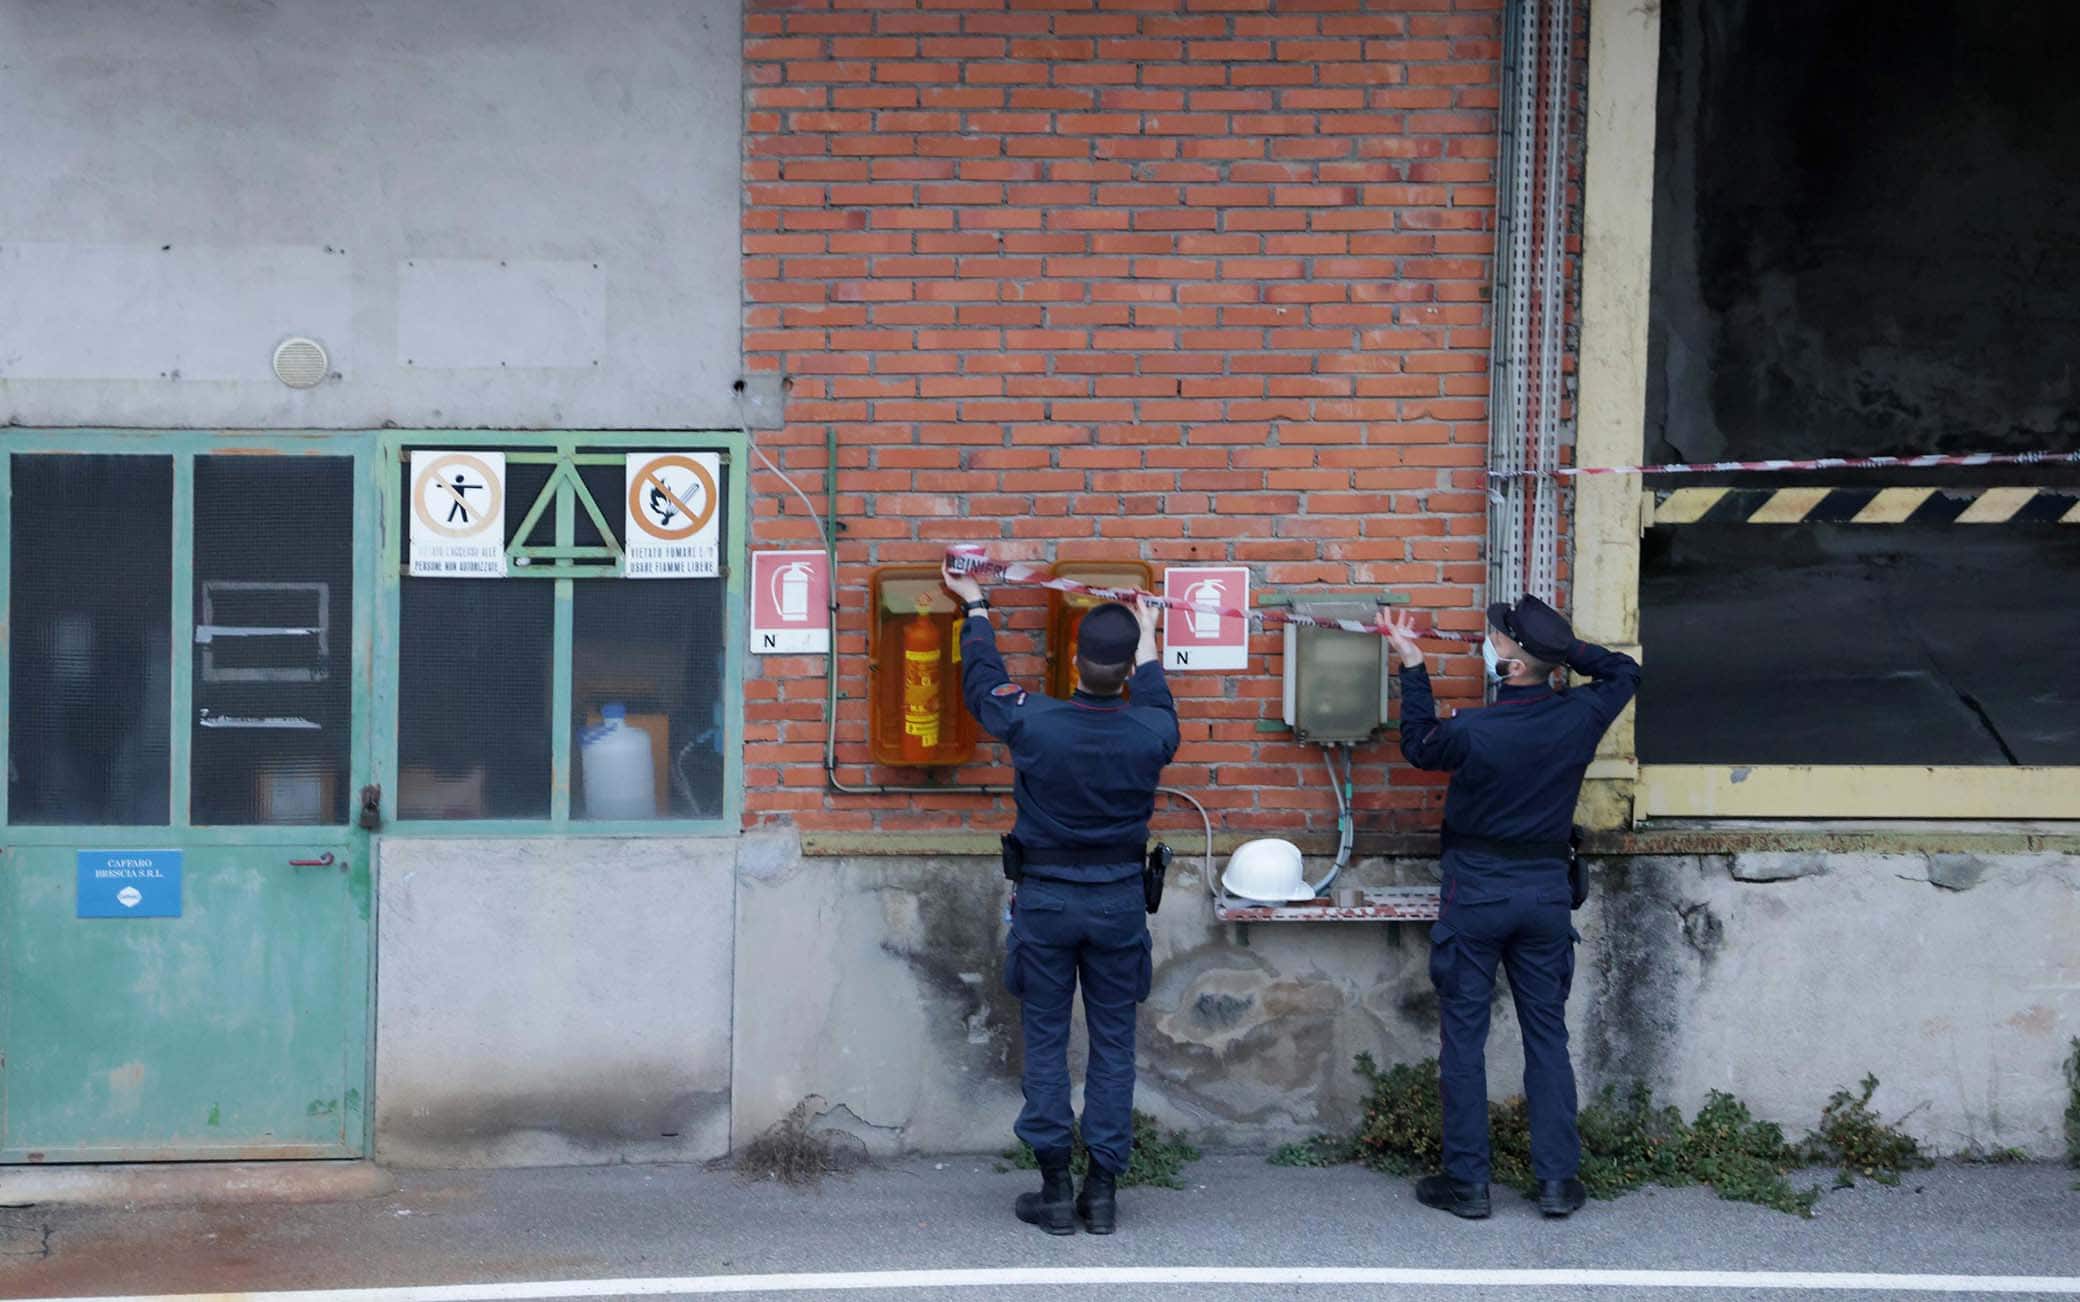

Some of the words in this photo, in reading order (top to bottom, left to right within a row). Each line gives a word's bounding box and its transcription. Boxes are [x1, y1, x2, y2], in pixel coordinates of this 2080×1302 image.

[630, 546, 662, 558] VIETATO
[665, 546, 697, 558] FUMARE
[414, 560, 442, 571] PERSONE
[444, 560, 457, 571] NON
[459, 560, 498, 571] AUTORIZZATE
[630, 561, 652, 573] USARE
[655, 561, 685, 573] FIAMME
[687, 561, 713, 573] LIBERE
[763, 633, 776, 648] N
[1176, 650, 1189, 665] N
[107, 859, 153, 868] CAFFARO
[95, 869, 138, 878] BRESCIA
